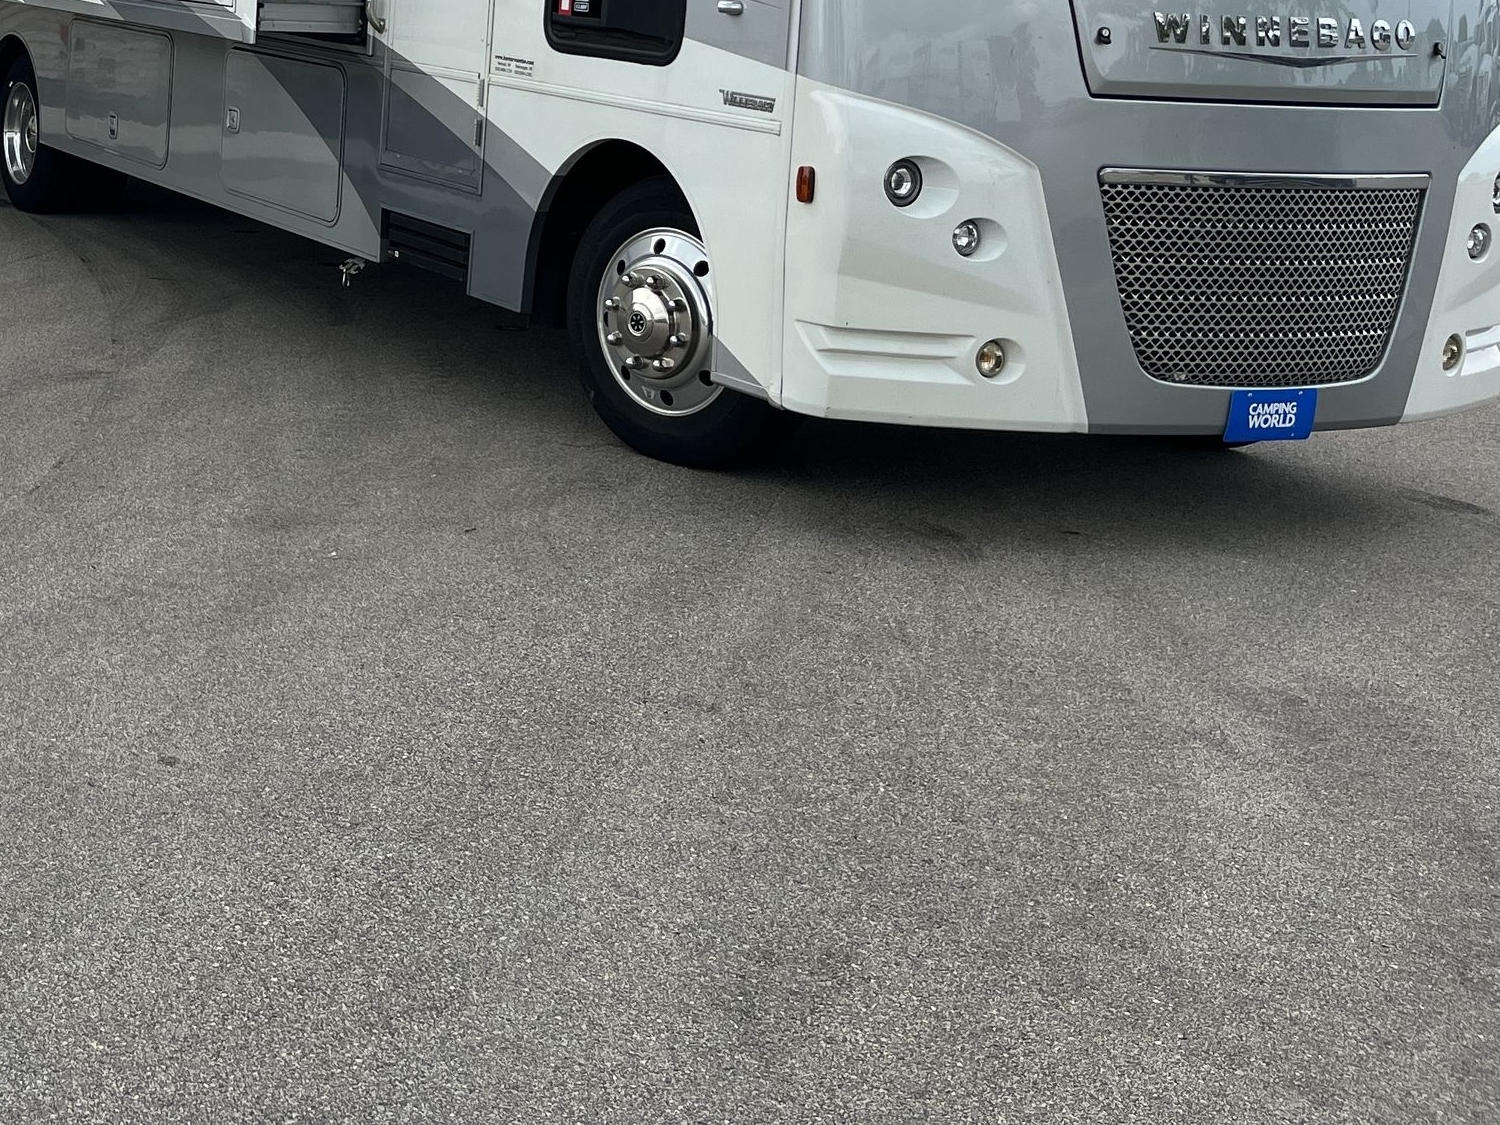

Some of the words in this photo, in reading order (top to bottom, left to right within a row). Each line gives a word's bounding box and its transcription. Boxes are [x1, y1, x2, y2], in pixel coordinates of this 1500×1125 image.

[1153, 11, 1417, 51] WINNEBAGO
[1249, 401, 1297, 415] CAMPING
[1248, 414, 1296, 429] WORLD
